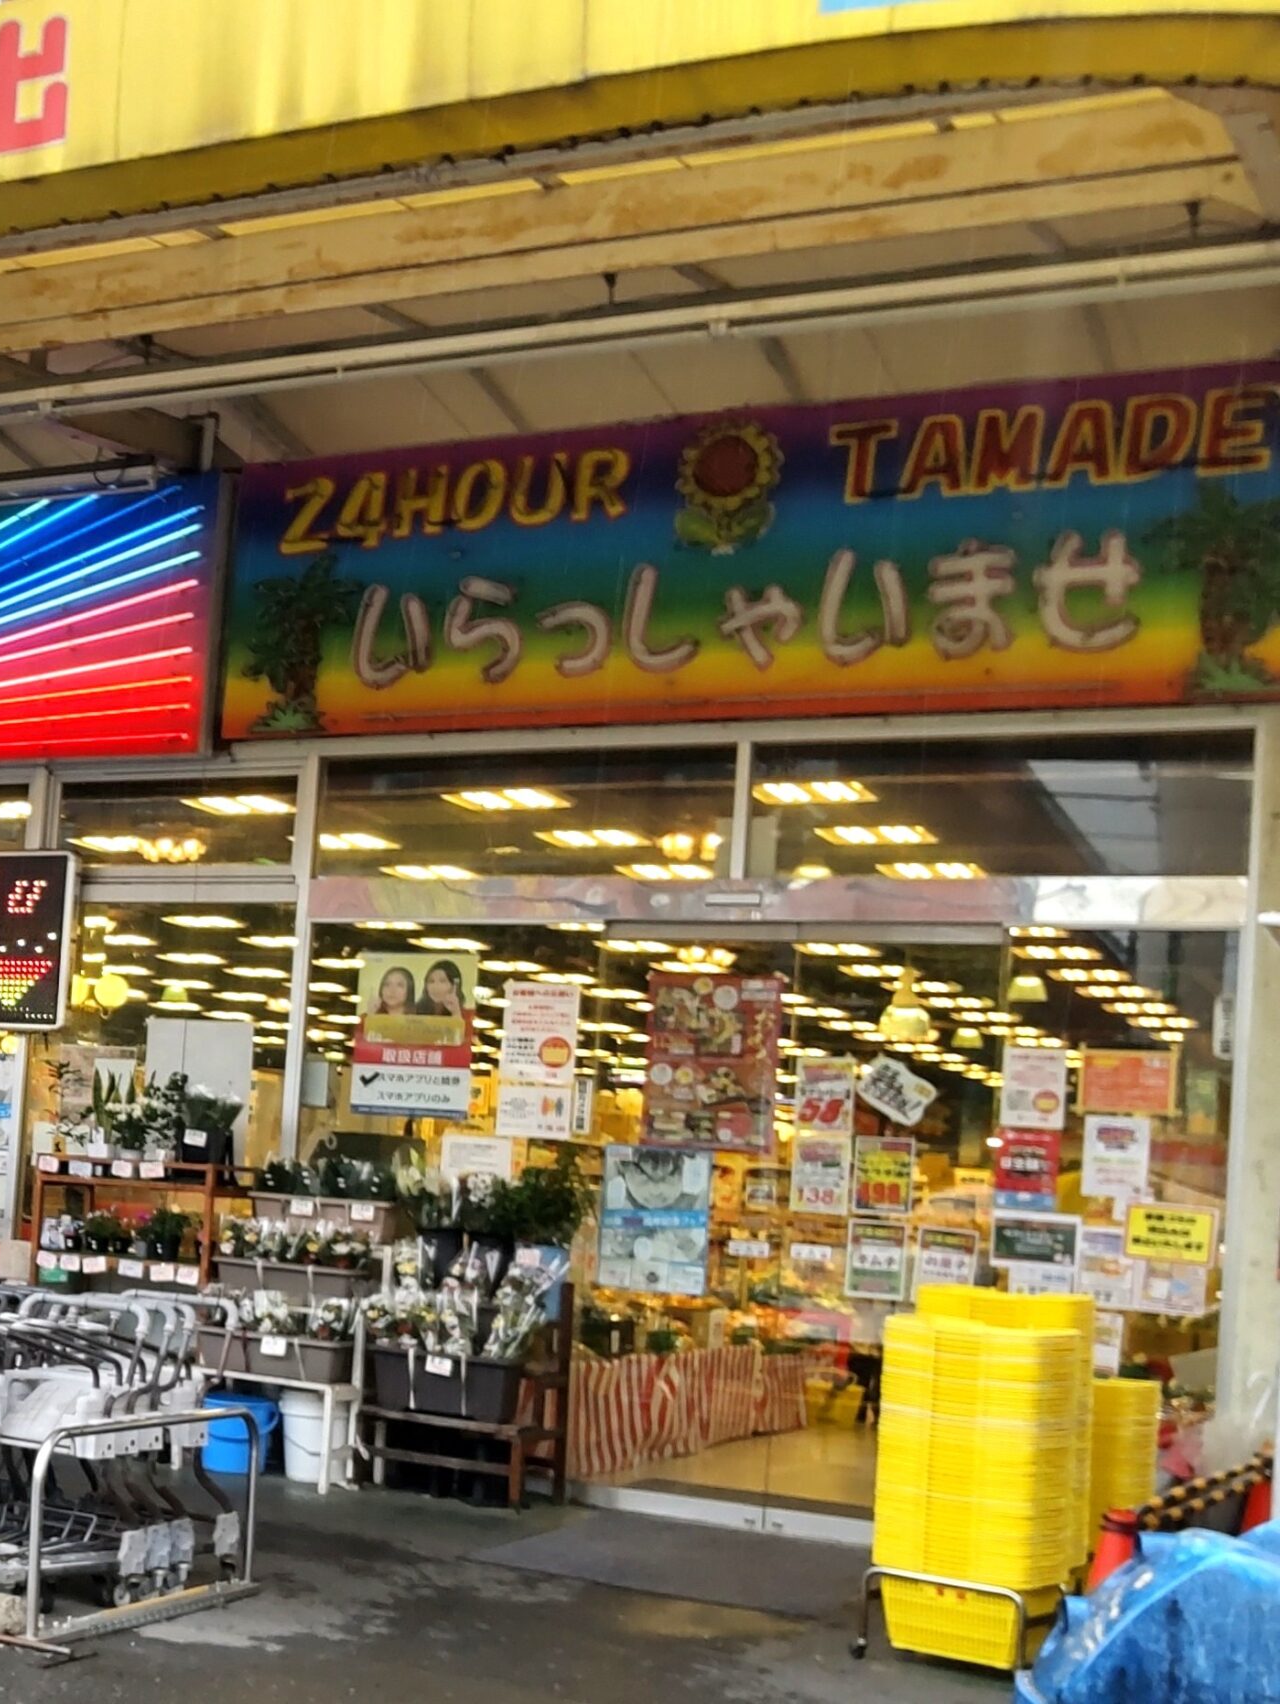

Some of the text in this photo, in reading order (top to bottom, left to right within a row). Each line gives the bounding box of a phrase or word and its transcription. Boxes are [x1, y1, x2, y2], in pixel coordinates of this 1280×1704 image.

[279, 382, 1276, 555] 24HOUR TAMADE
[352, 528, 1141, 690] いらっしゃいませ
